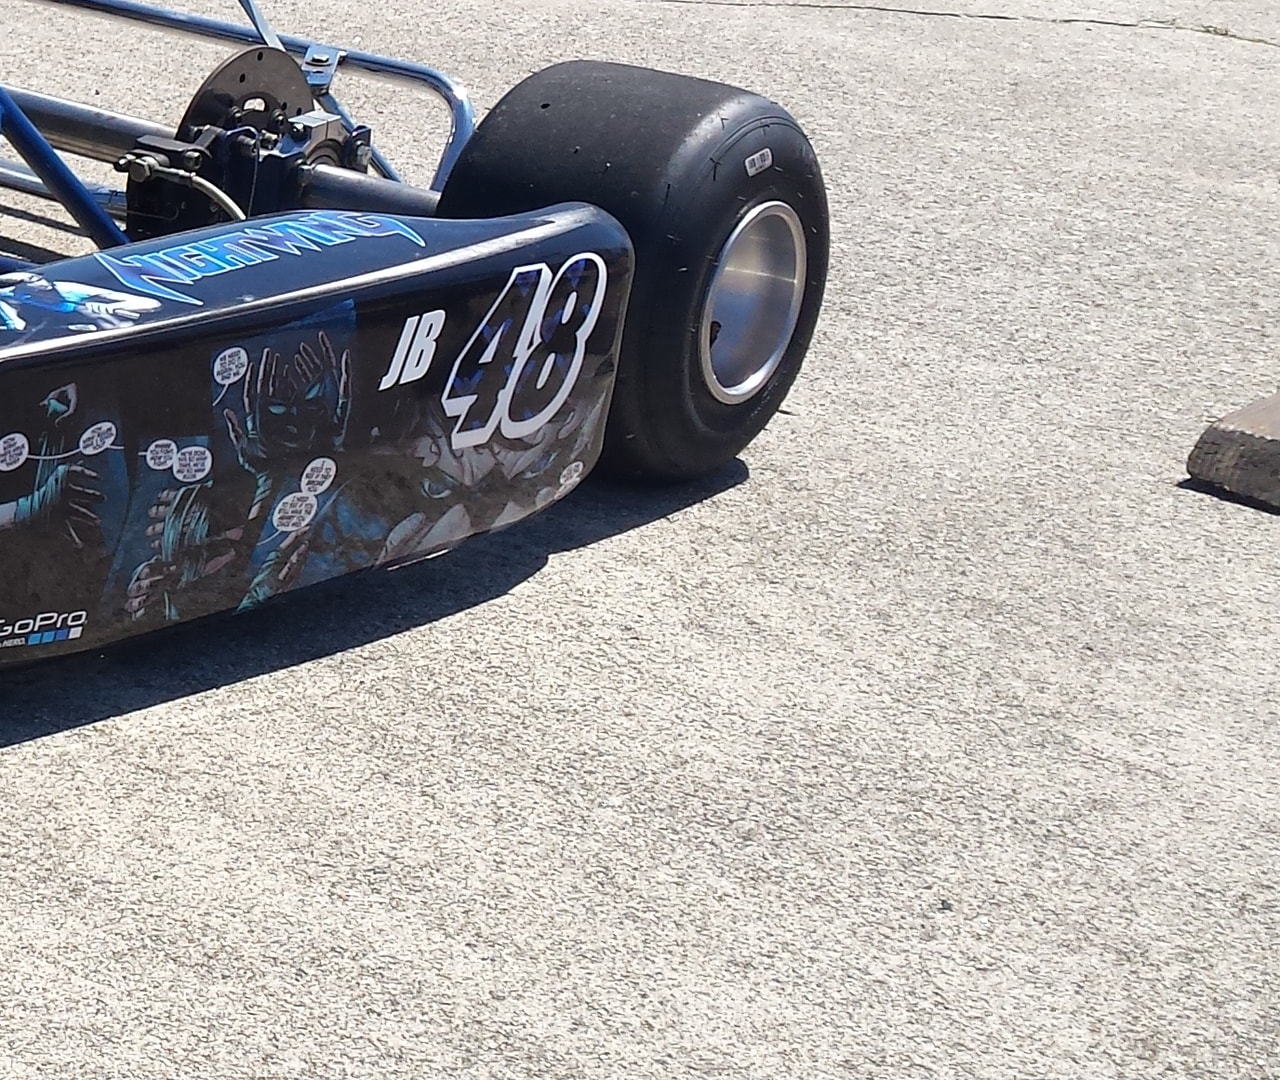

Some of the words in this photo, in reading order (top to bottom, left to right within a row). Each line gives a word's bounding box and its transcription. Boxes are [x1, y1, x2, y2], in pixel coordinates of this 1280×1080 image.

[93, 210, 426, 306] NIGHTWING
[378, 309, 446, 392] JB
[441, 252, 608, 450] 48
